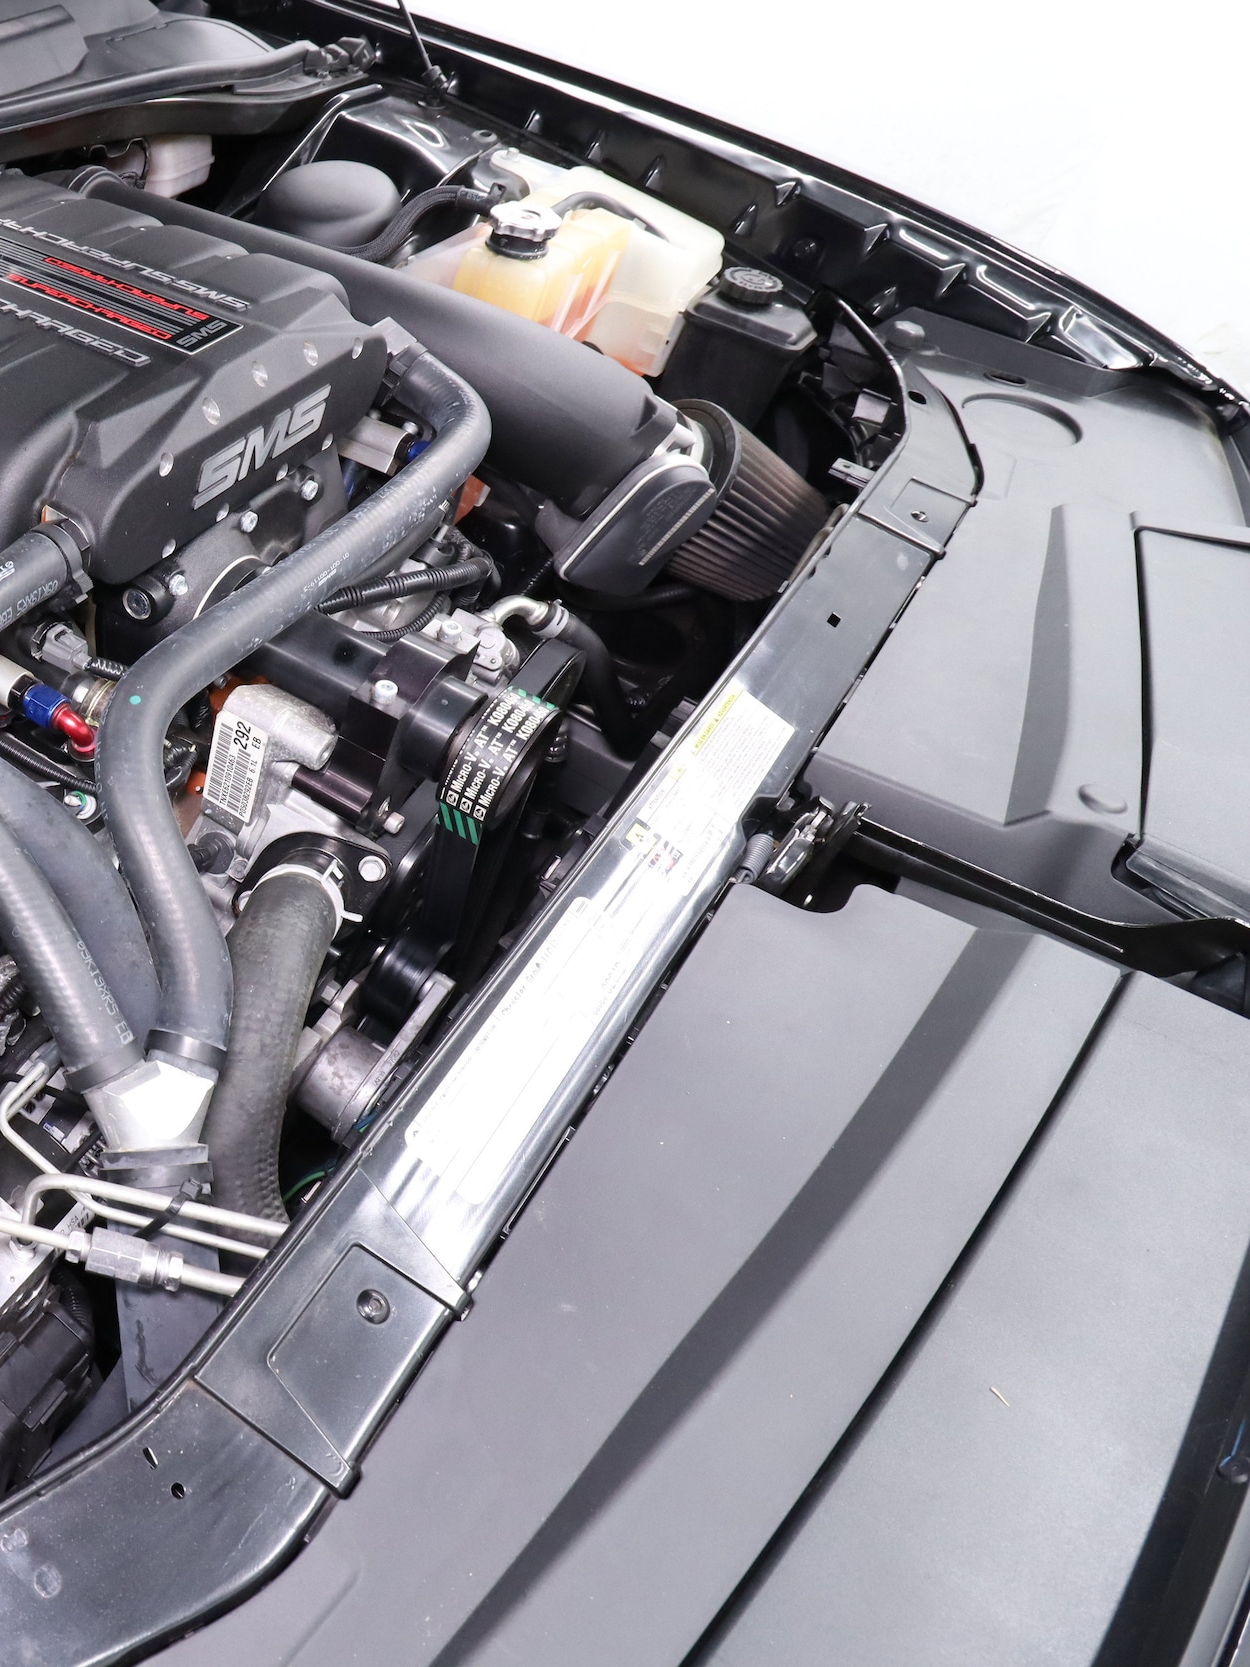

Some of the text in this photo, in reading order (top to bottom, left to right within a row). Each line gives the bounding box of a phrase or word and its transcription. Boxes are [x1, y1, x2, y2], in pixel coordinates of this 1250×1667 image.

[44, 256, 210, 321] SUPERCHARGED
[172, 279, 250, 312] SMS
[5, 273, 173, 340] SUPERCHARGED
[176, 319, 228, 348] SMS
[192, 383, 332, 511] SMS
[234, 721, 251, 751] 292
[252, 736, 262, 750] EB
